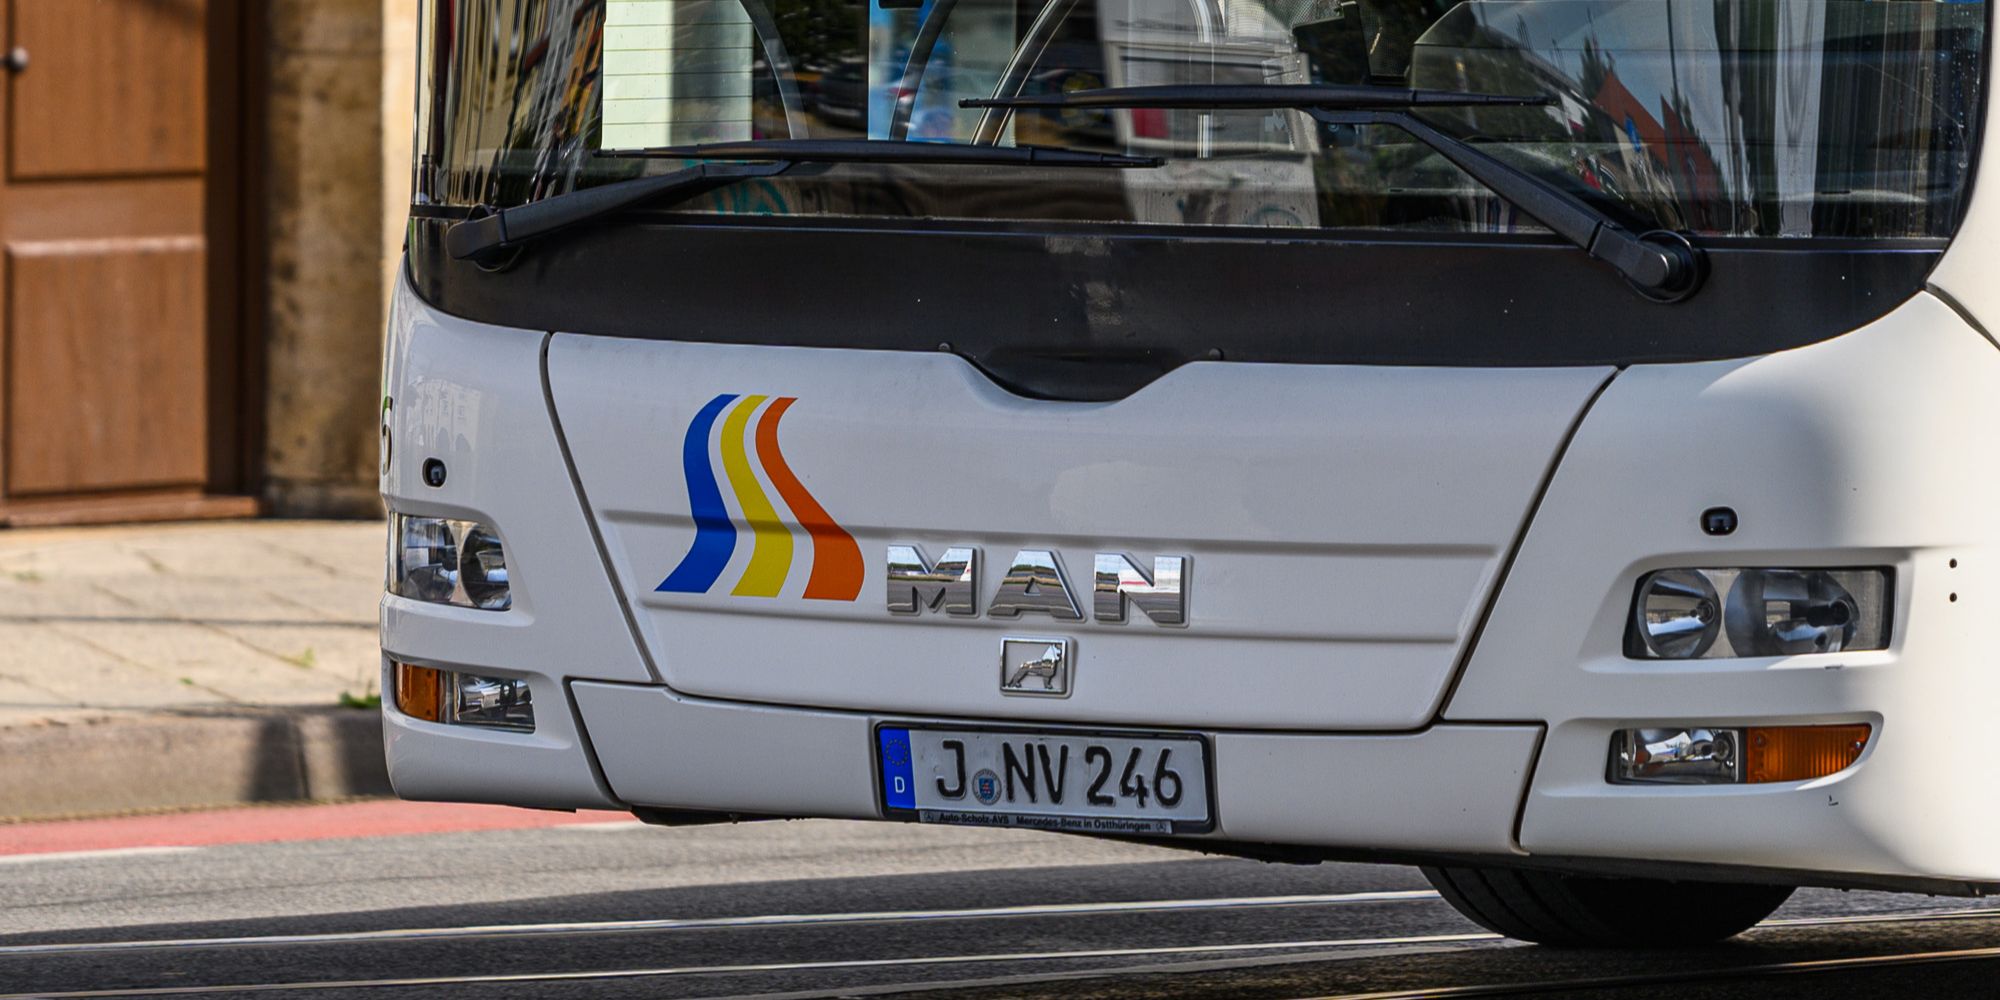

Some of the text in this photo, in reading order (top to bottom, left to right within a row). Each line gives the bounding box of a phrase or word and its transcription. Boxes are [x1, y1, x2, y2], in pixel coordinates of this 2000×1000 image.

[887, 544, 1191, 628] MAN
[894, 776, 906, 793] D
[936, 740, 965, 799] J
[1002, 742, 1069, 804] NV
[1085, 745, 1183, 808] 246
[1016, 815, 1082, 829] Mercedes-Benz
[1084, 818, 1093, 829] in
[1094, 818, 1151, 832] Ostthüringen
